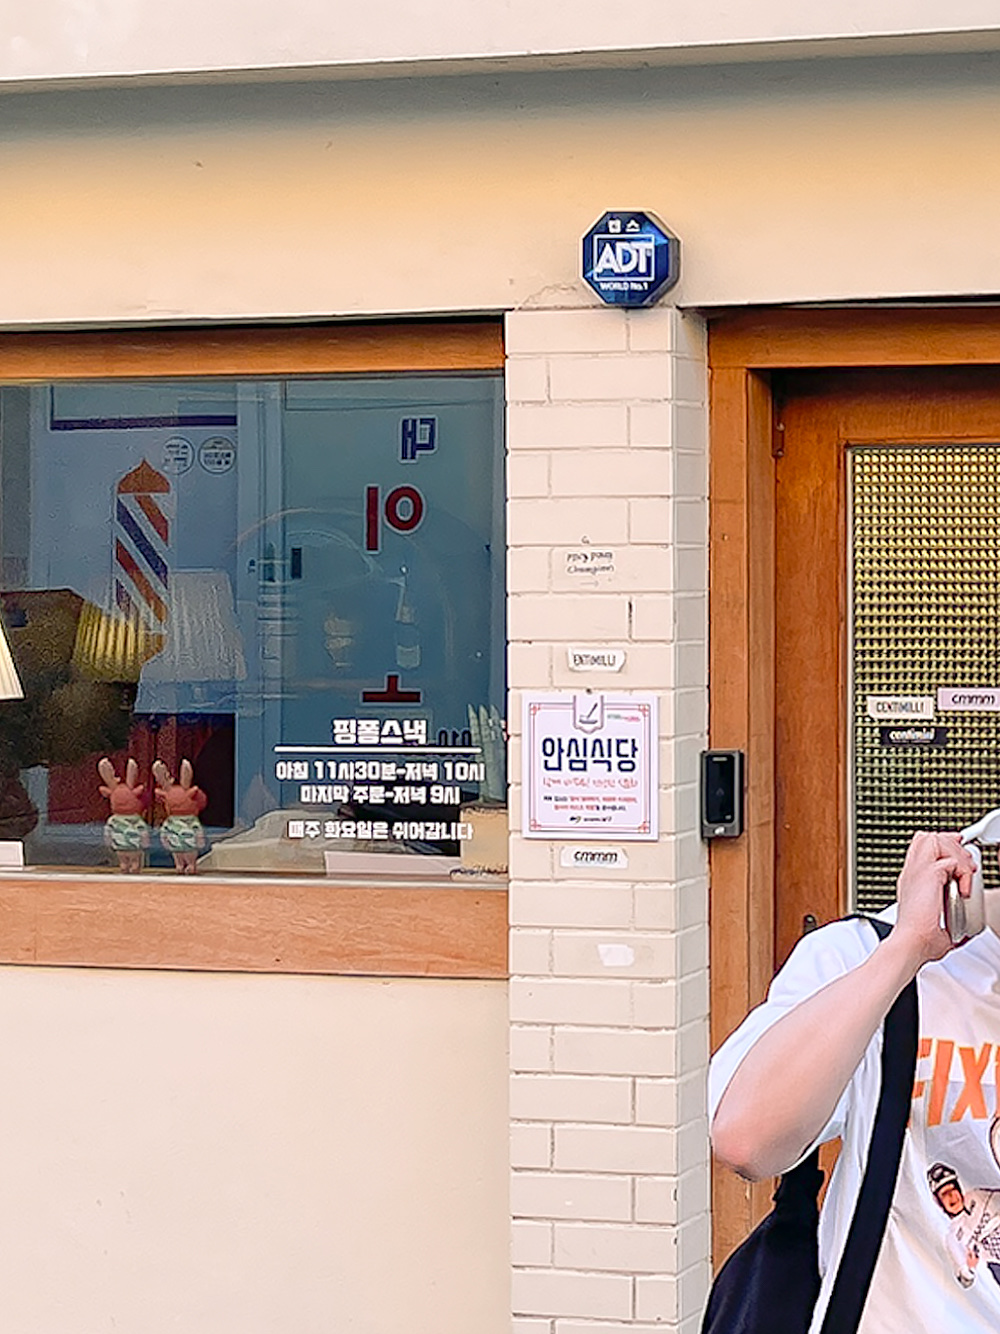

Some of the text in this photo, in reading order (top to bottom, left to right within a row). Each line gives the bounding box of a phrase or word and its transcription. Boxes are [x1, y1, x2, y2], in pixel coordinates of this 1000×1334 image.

[594, 241, 653, 273] ADT
[600, 282, 629, 290] WORLD
[333, 719, 427, 744] 핑퐁스낵
[542, 738, 639, 772] 안심식당
[276, 761, 309, 780] 아침
[443, 762, 485, 781] 10시
[300, 785, 350, 804] 마지막
[430, 785, 461, 805] 9시
[288, 821, 474, 841] 매주 화요일은 쉬어갑니다
